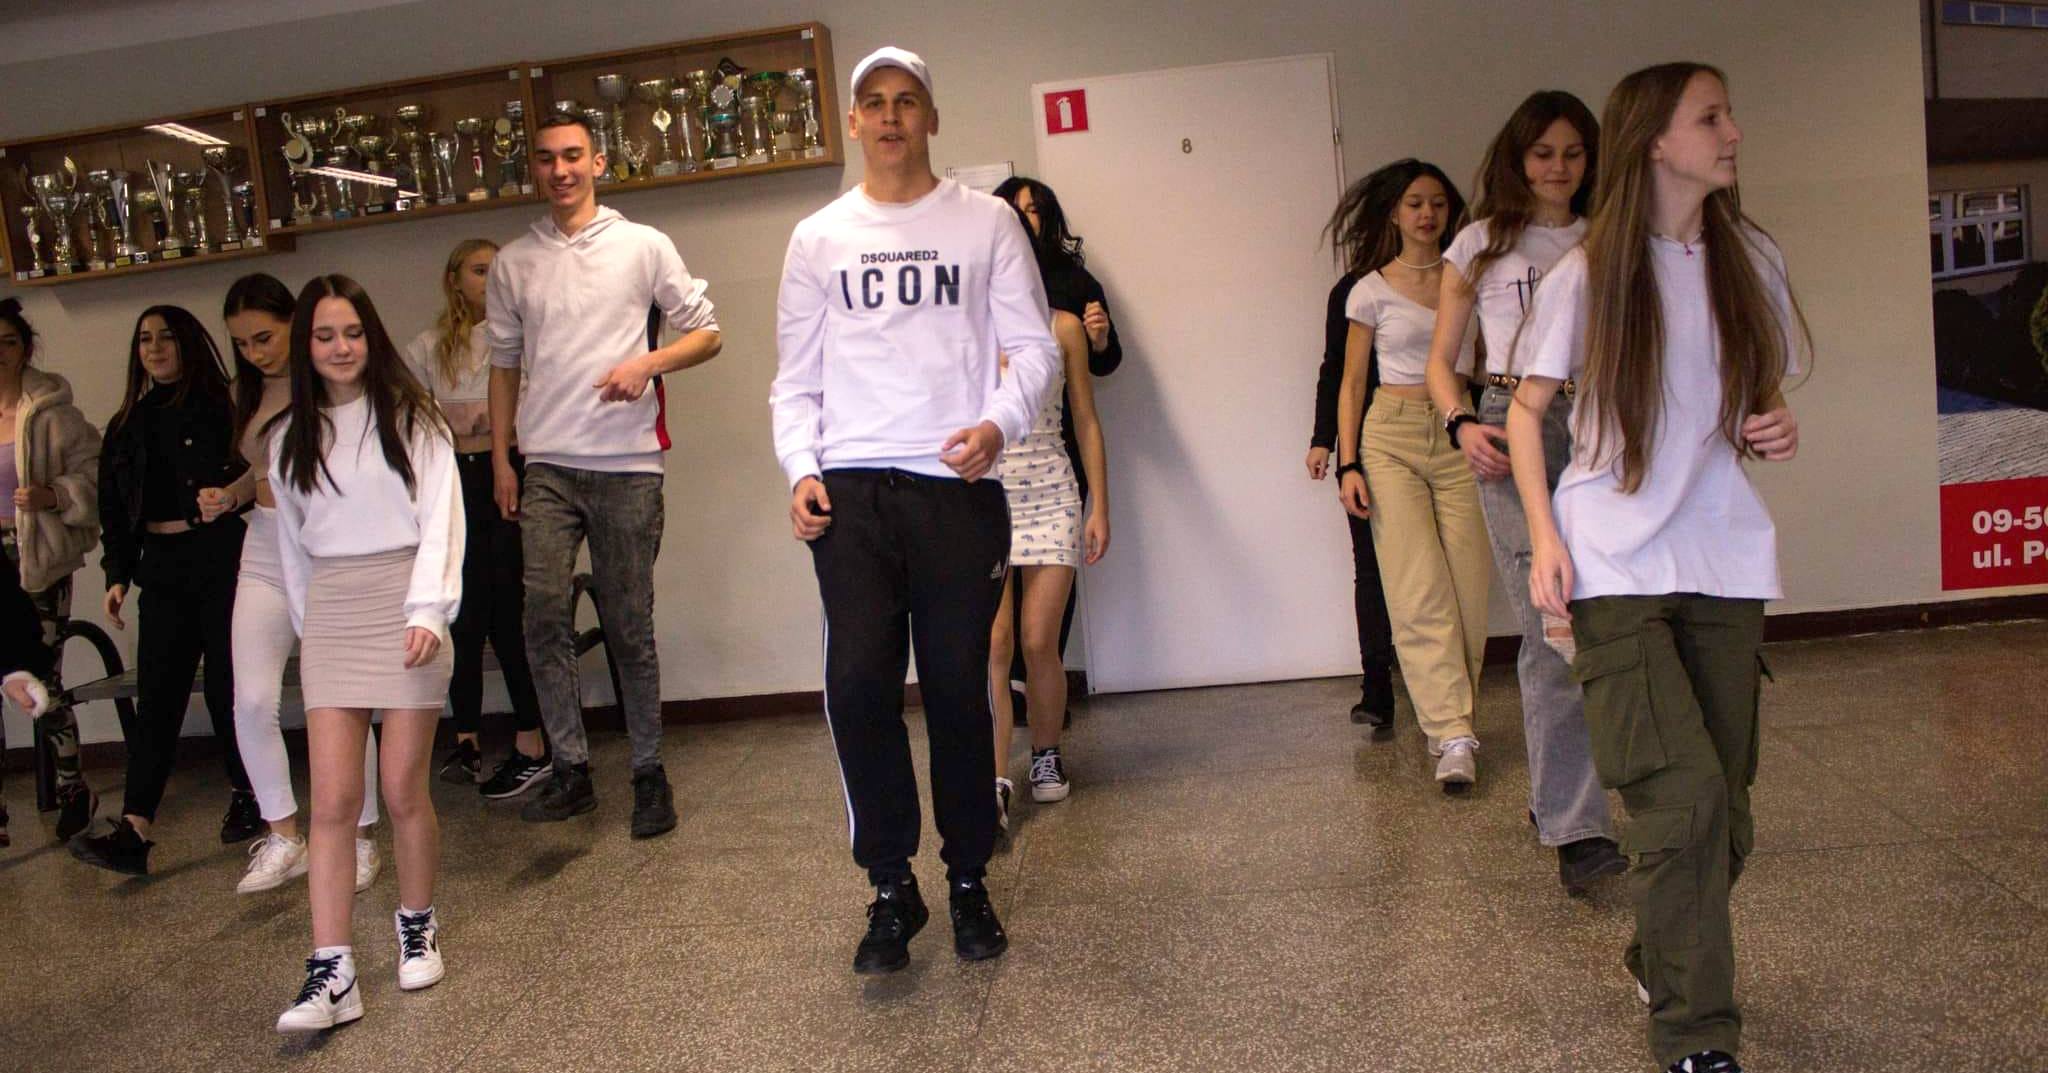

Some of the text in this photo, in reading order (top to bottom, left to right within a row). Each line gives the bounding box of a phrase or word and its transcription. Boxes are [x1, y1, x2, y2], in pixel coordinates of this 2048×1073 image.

[1181, 137, 1193, 154] 8
[861, 250, 939, 264] DSQUARED2
[840, 264, 960, 310] ICON
[1972, 506, 2048, 534] 09-5
[1973, 540, 2048, 568] ul. P
